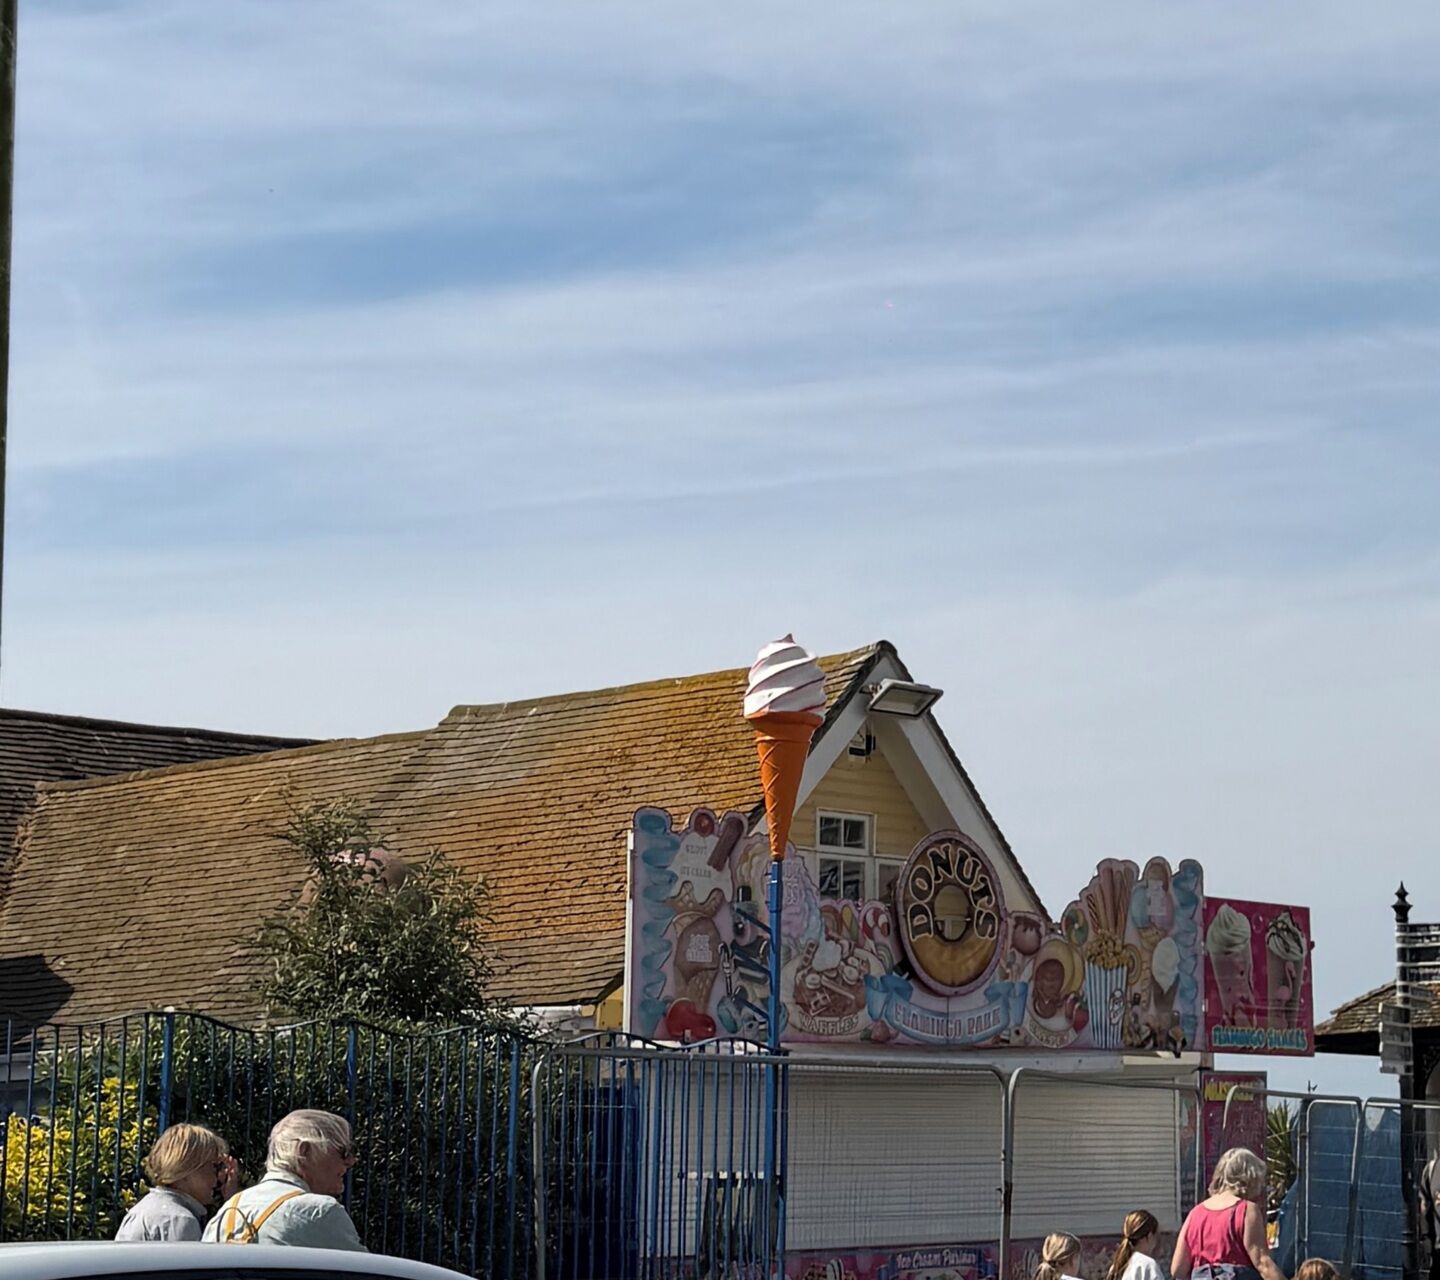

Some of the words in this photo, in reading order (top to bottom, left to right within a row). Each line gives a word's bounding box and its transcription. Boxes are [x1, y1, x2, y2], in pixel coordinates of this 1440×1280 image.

[908, 842, 998, 942] DONUTS
[801, 1012, 859, 1036] WAFFLES
[894, 1002, 963, 1040] FLAMINGO
[966, 1006, 1002, 1038] PARK
[1212, 1024, 1266, 1050] FLAMINGO
